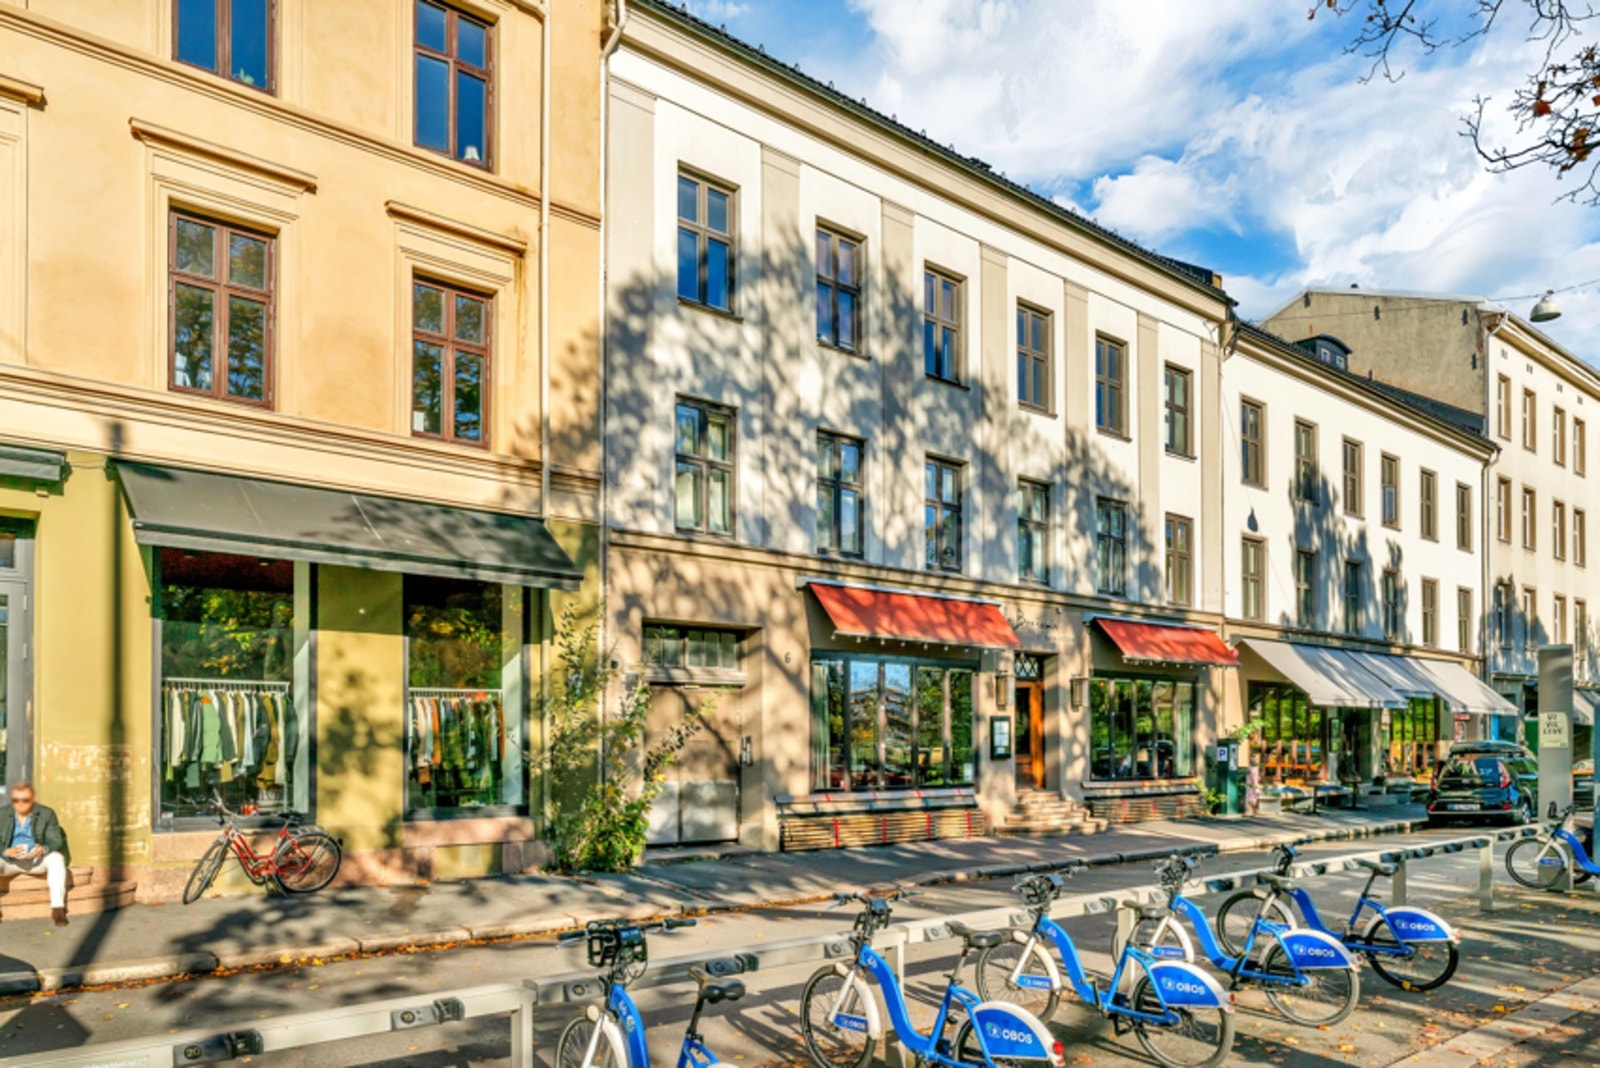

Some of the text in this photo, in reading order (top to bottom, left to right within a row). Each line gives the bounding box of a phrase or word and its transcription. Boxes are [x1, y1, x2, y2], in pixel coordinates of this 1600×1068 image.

[784, 651, 791, 664] 6
[1219, 748, 1226, 759] P
[1409, 922, 1436, 931] OBOS
[1307, 946, 1336, 958] OBOS
[1175, 982, 1206, 995] OBOS
[1002, 1027, 1033, 1045] OBOS
[186, 1047, 201, 1057] 20
